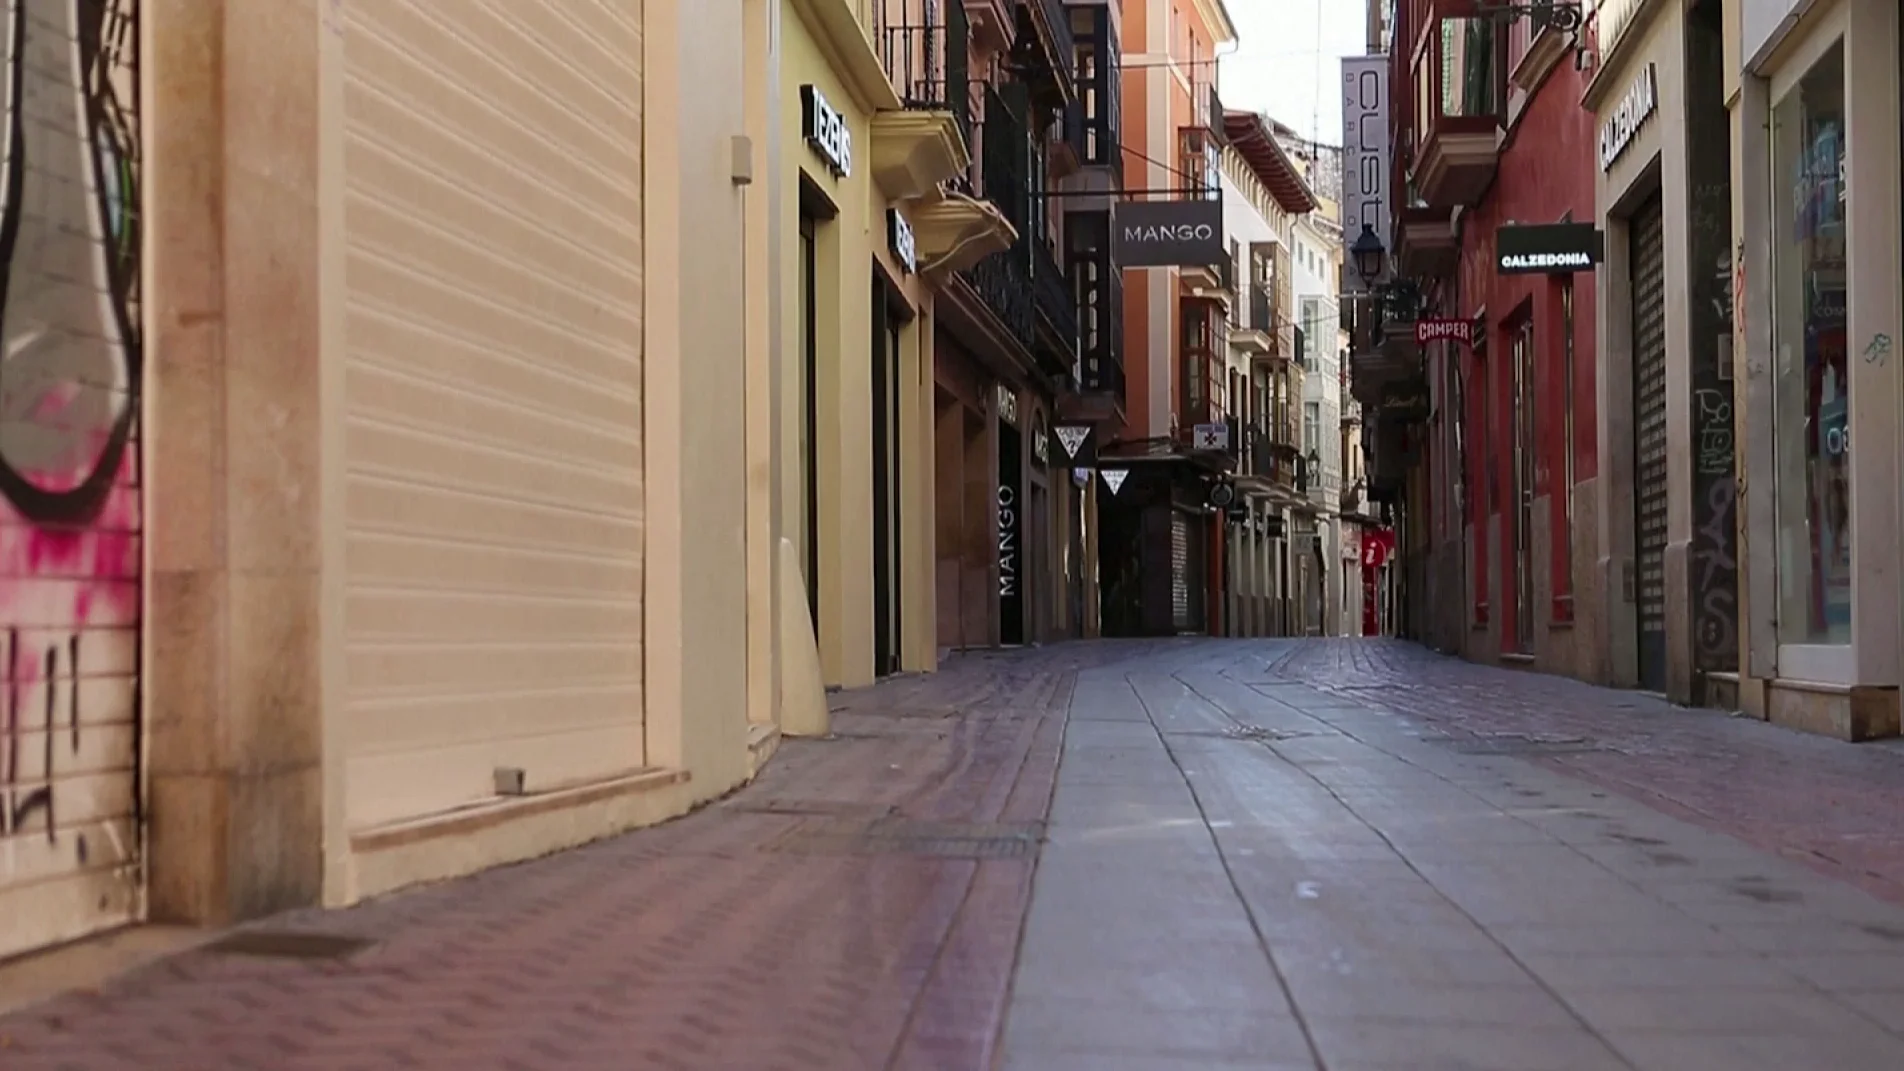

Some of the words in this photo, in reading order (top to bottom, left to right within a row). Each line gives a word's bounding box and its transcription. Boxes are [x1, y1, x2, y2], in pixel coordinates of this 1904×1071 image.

[1124, 224, 1213, 242] MANGO
[1501, 251, 1590, 268] CALZEDONIA
[1418, 321, 1470, 341] CAMPER
[997, 484, 1016, 596] MANGO
